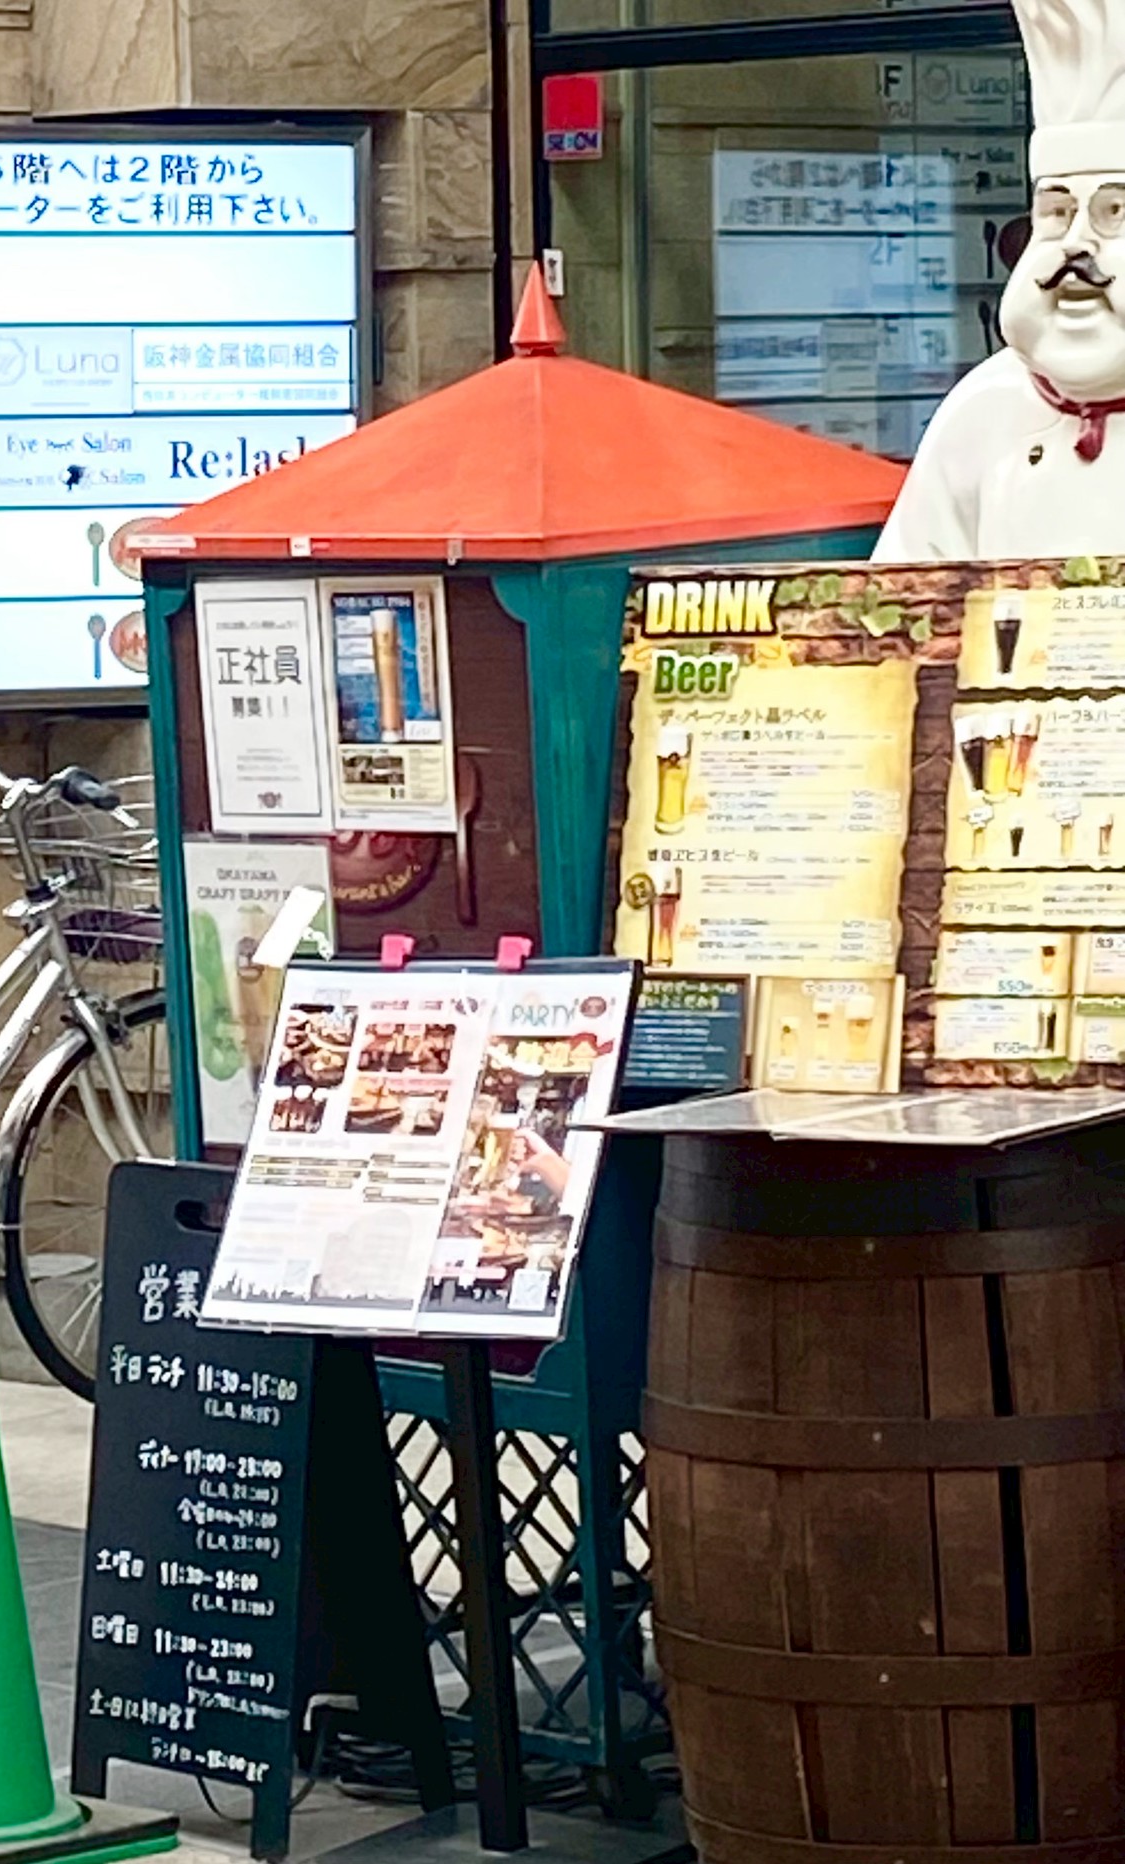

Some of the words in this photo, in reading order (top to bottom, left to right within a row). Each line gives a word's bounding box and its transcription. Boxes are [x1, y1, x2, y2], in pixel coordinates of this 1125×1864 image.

[34, 345, 120, 374] Luna
[143, 342, 339, 369] 阪神金属協同組合
[7, 433, 38, 459] Eye
[82, 431, 132, 453] Salon
[644, 579, 777, 635] DRINK
[215, 645, 302, 686] 正社員
[652, 654, 734, 695] Beer
[511, 1003, 576, 1028] PARTY
[138, 1262, 202, 1323] 営業
[109, 1344, 143, 1385] 平日
[90, 1613, 140, 1645] 日曜日
